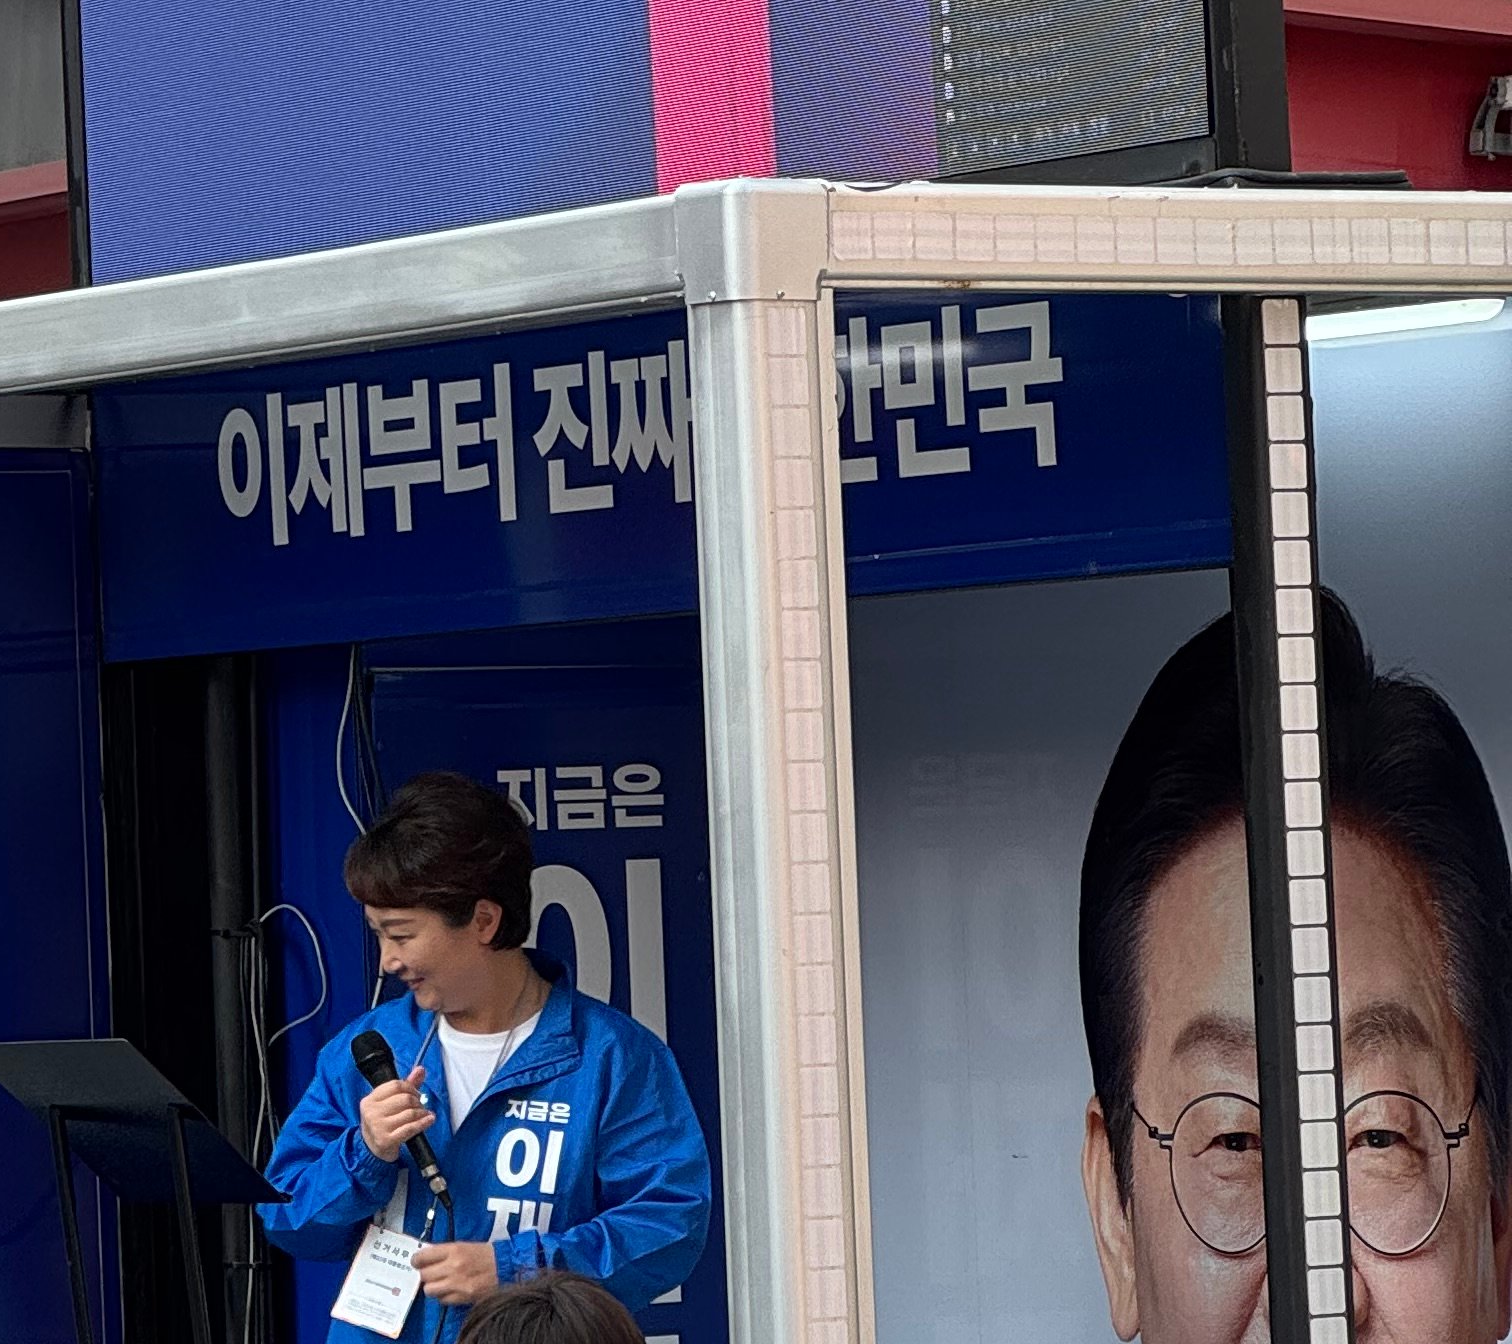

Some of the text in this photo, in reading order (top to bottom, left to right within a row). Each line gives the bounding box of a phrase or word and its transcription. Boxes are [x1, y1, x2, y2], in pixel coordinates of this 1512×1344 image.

[218, 301, 1063, 545] 이제부터 진짜 한민국
[497, 763, 664, 830] 지금은
[505, 1099, 571, 1124] 지금은
